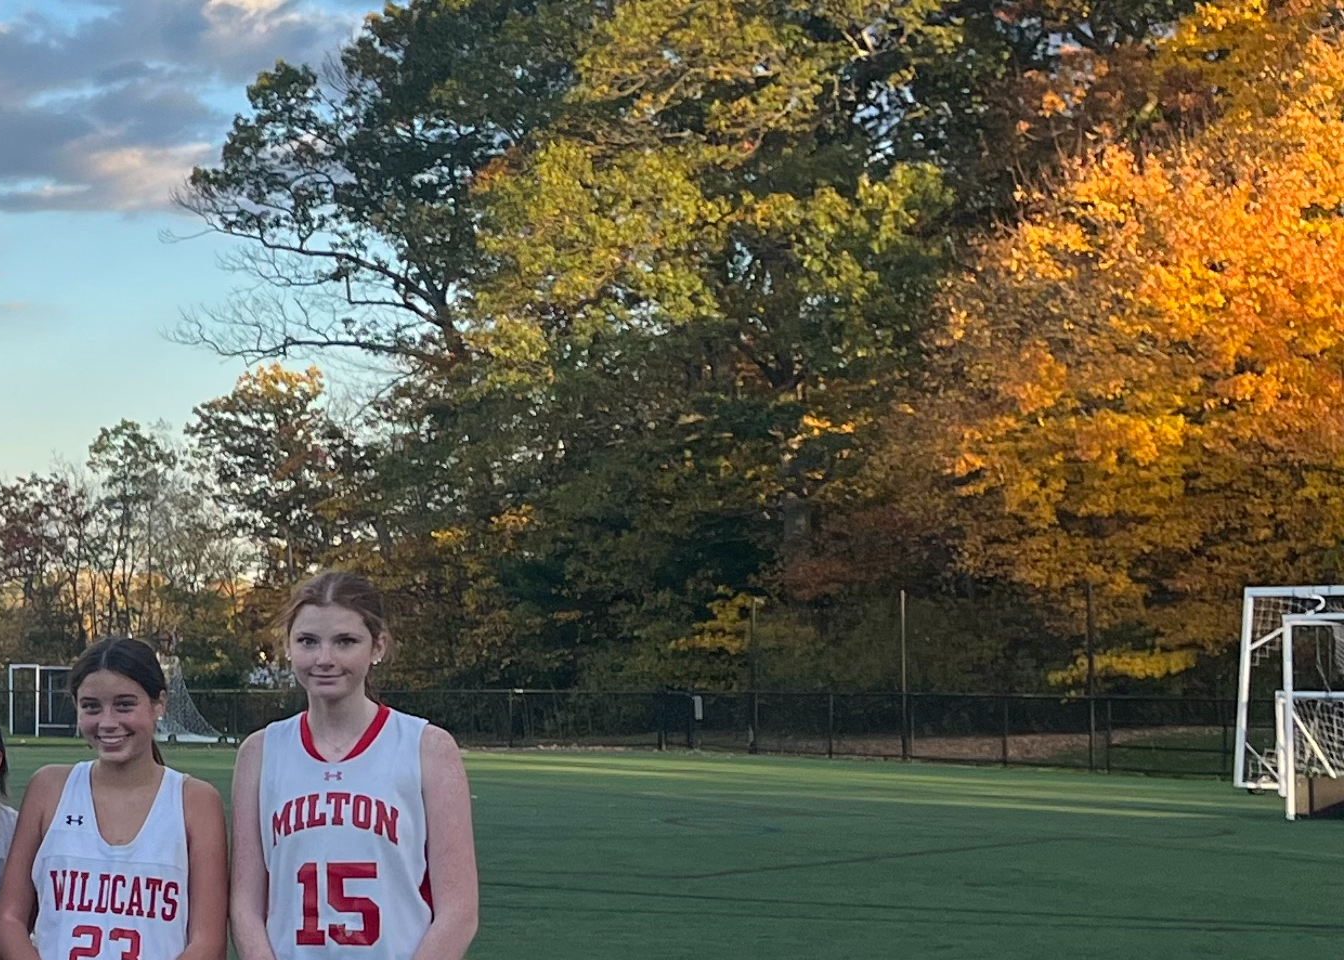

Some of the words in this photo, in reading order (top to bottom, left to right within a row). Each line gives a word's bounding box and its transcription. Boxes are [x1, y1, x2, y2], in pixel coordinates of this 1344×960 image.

[272, 792, 399, 846] MILTON
[49, 869, 179, 922] WILDCATS
[296, 862, 381, 946] 15
